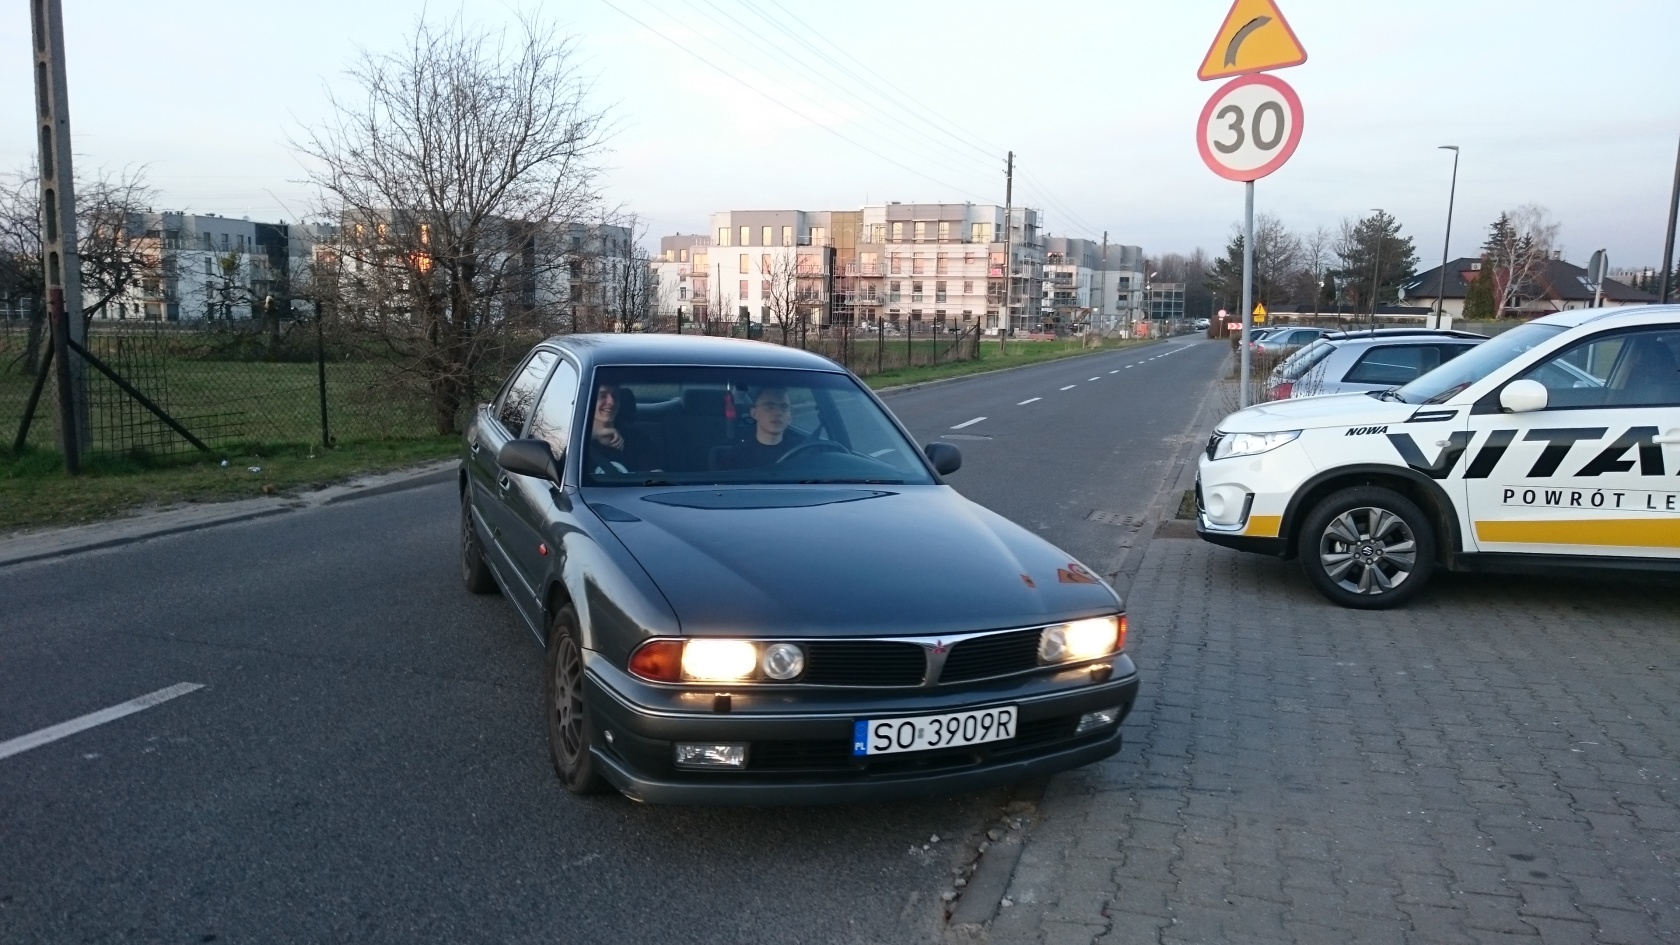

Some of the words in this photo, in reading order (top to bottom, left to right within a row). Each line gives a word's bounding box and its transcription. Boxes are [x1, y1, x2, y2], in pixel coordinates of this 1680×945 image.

[1213, 100, 1285, 154] 30
[1344, 425, 1389, 437] NOWA
[1385, 426, 1680, 479] VITA
[1503, 489, 1625, 508] POWRÓT
[927, 709, 1012, 746] 3909R
[854, 742, 866, 751] PL
